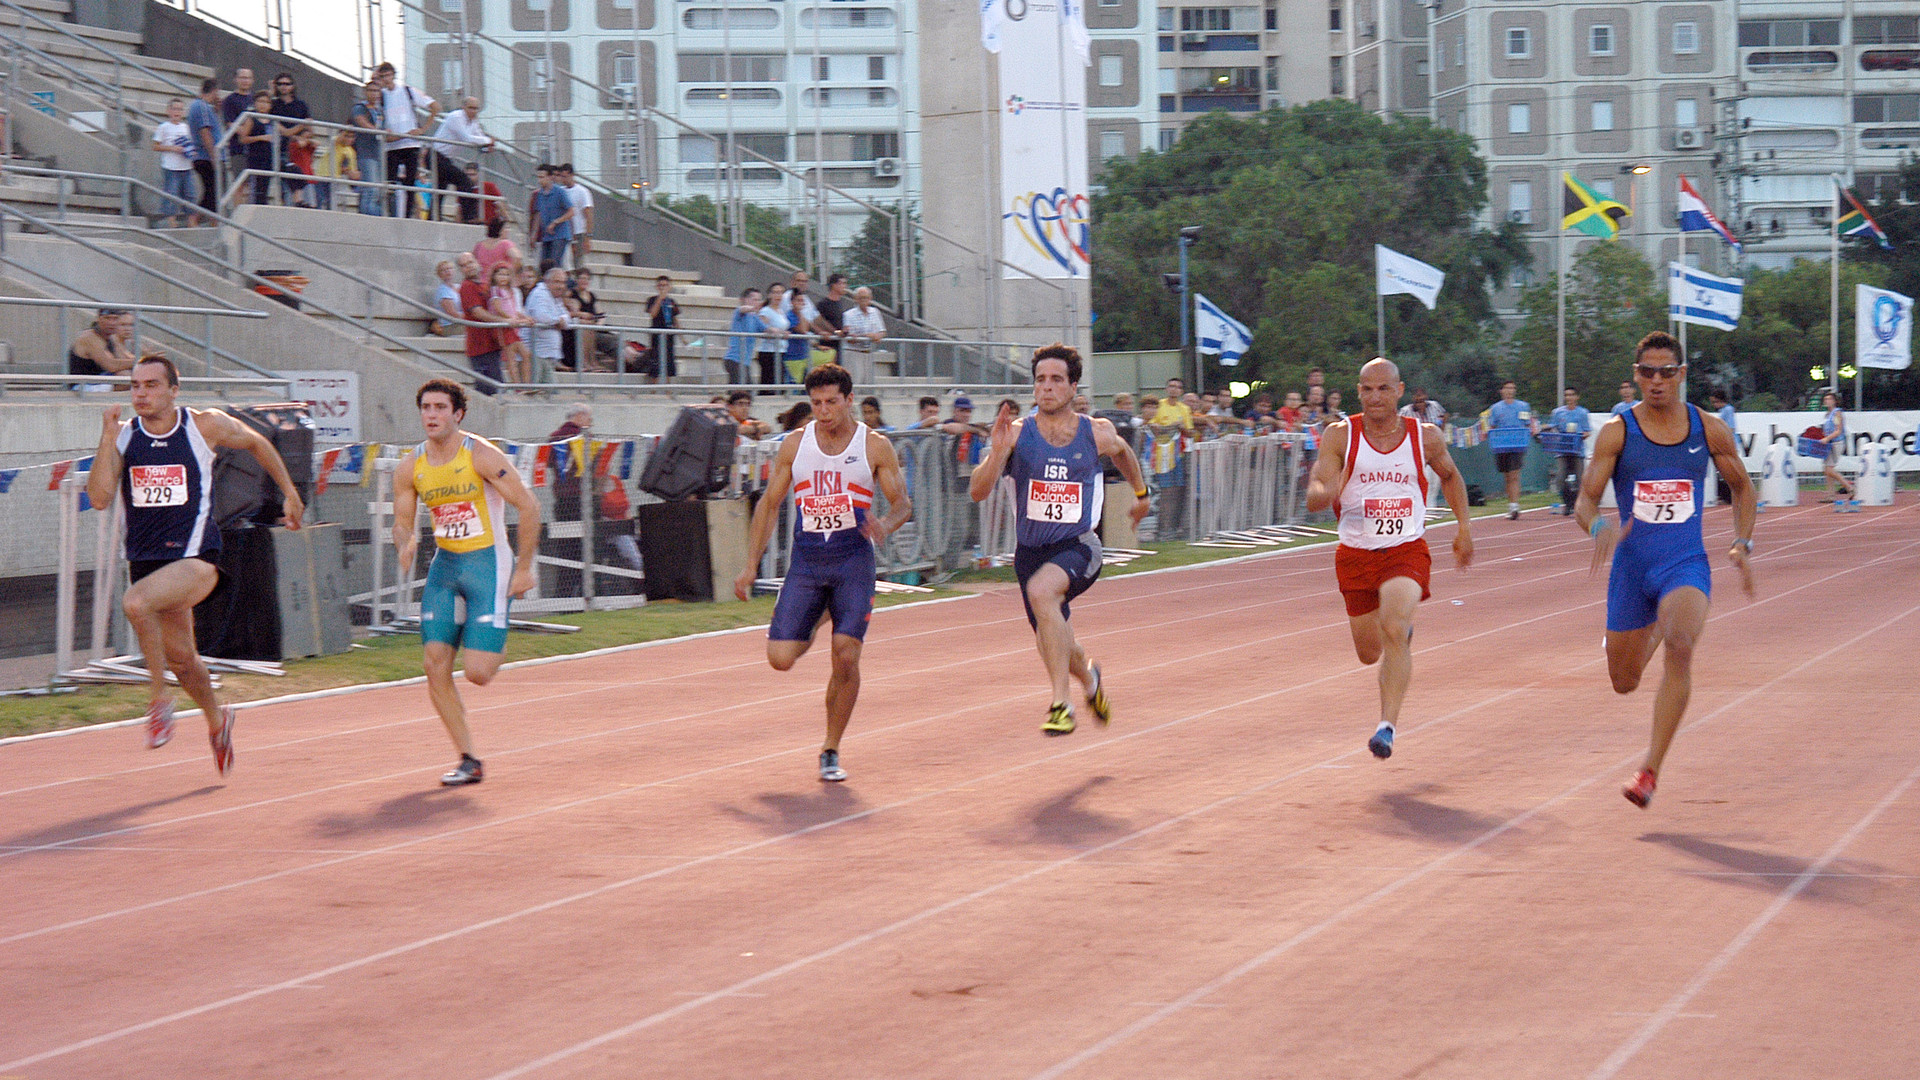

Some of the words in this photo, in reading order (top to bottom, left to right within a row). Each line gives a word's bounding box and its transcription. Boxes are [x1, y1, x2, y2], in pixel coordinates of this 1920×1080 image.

[1047, 457, 1067, 465] ISRAEL
[144, 467, 168, 478] new
[1044, 464, 1068, 480] ISR
[1360, 471, 1409, 485] CANADA
[135, 476, 181, 486] balance
[813, 470, 843, 496] USA
[1044, 483, 1067, 493] new
[1652, 483, 1677, 493] new
[143, 487, 172, 504] 229
[814, 496, 836, 506] new
[1033, 489, 1077, 503] balance
[1639, 491, 1689, 502] balance
[805, 504, 848, 516] balance
[1378, 499, 1401, 508] new
[1044, 503, 1063, 520] 43
[1367, 506, 1411, 518] balance
[1654, 504, 1675, 521] 75
[814, 515, 843, 530] 235
[1375, 519, 1403, 535] 239
[444, 522, 470, 539] 222
